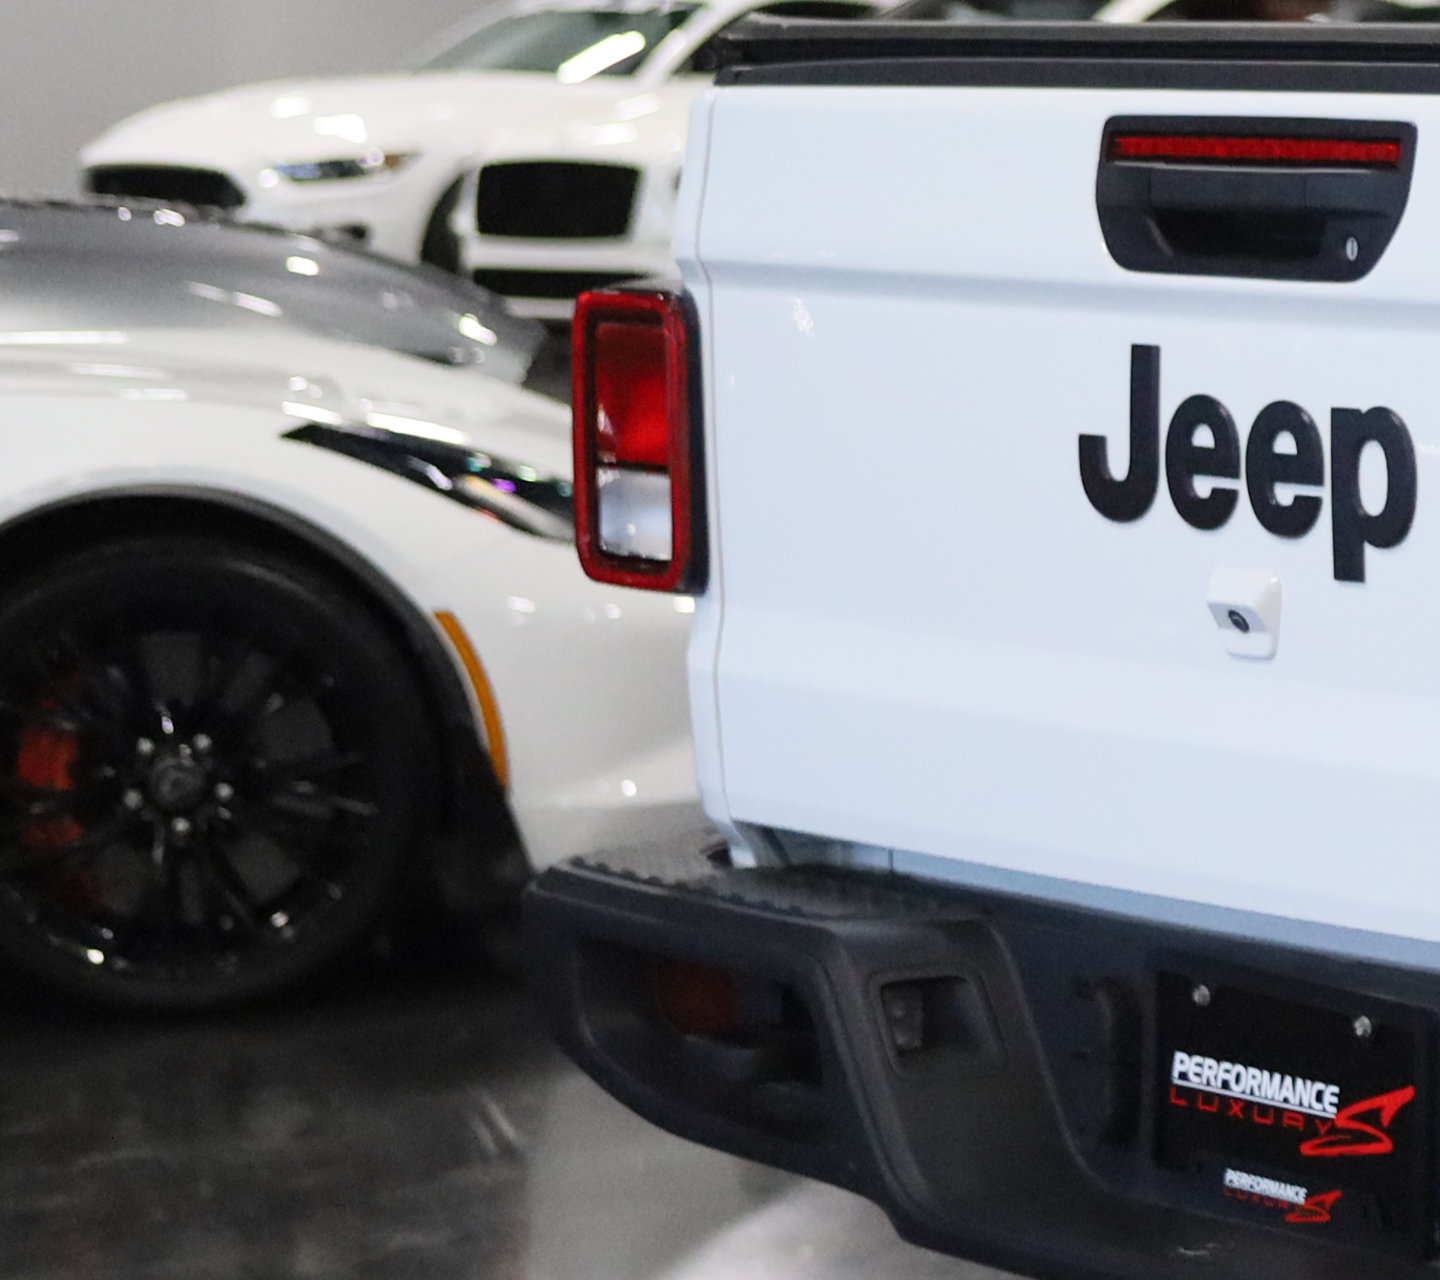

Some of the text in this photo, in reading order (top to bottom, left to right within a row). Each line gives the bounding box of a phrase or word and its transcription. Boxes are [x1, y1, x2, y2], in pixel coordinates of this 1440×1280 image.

[1078, 343, 1418, 584] Jeep
[1169, 1085, 1333, 1135] LUXURY
[1171, 1049, 1340, 1115] PERFORMANCE
[1223, 1167, 1308, 1205] PERFORMANCE
